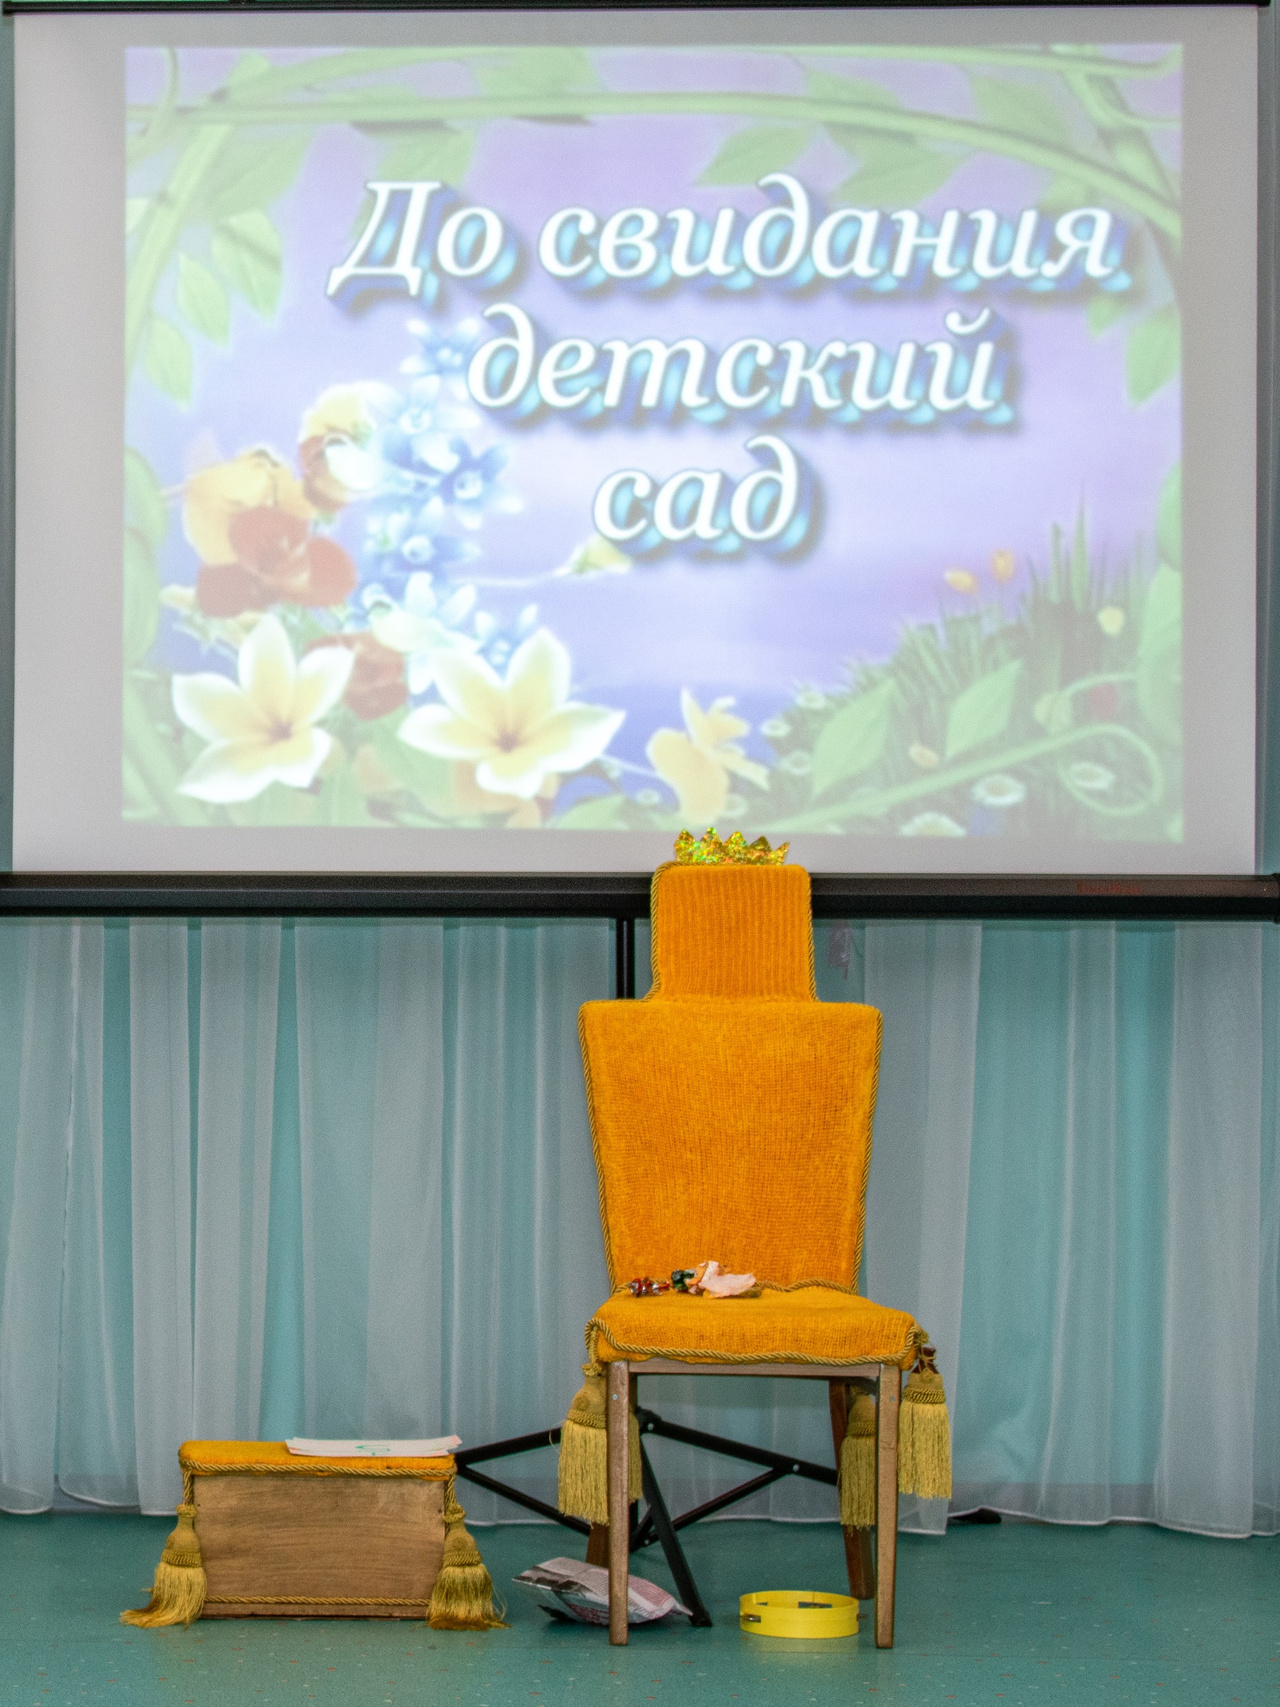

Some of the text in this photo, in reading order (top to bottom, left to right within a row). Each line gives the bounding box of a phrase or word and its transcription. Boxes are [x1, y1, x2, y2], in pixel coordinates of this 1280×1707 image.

[327, 173, 1119, 298] До свидания
[466, 303, 997, 412] детский
[591, 434, 800, 541] сад
